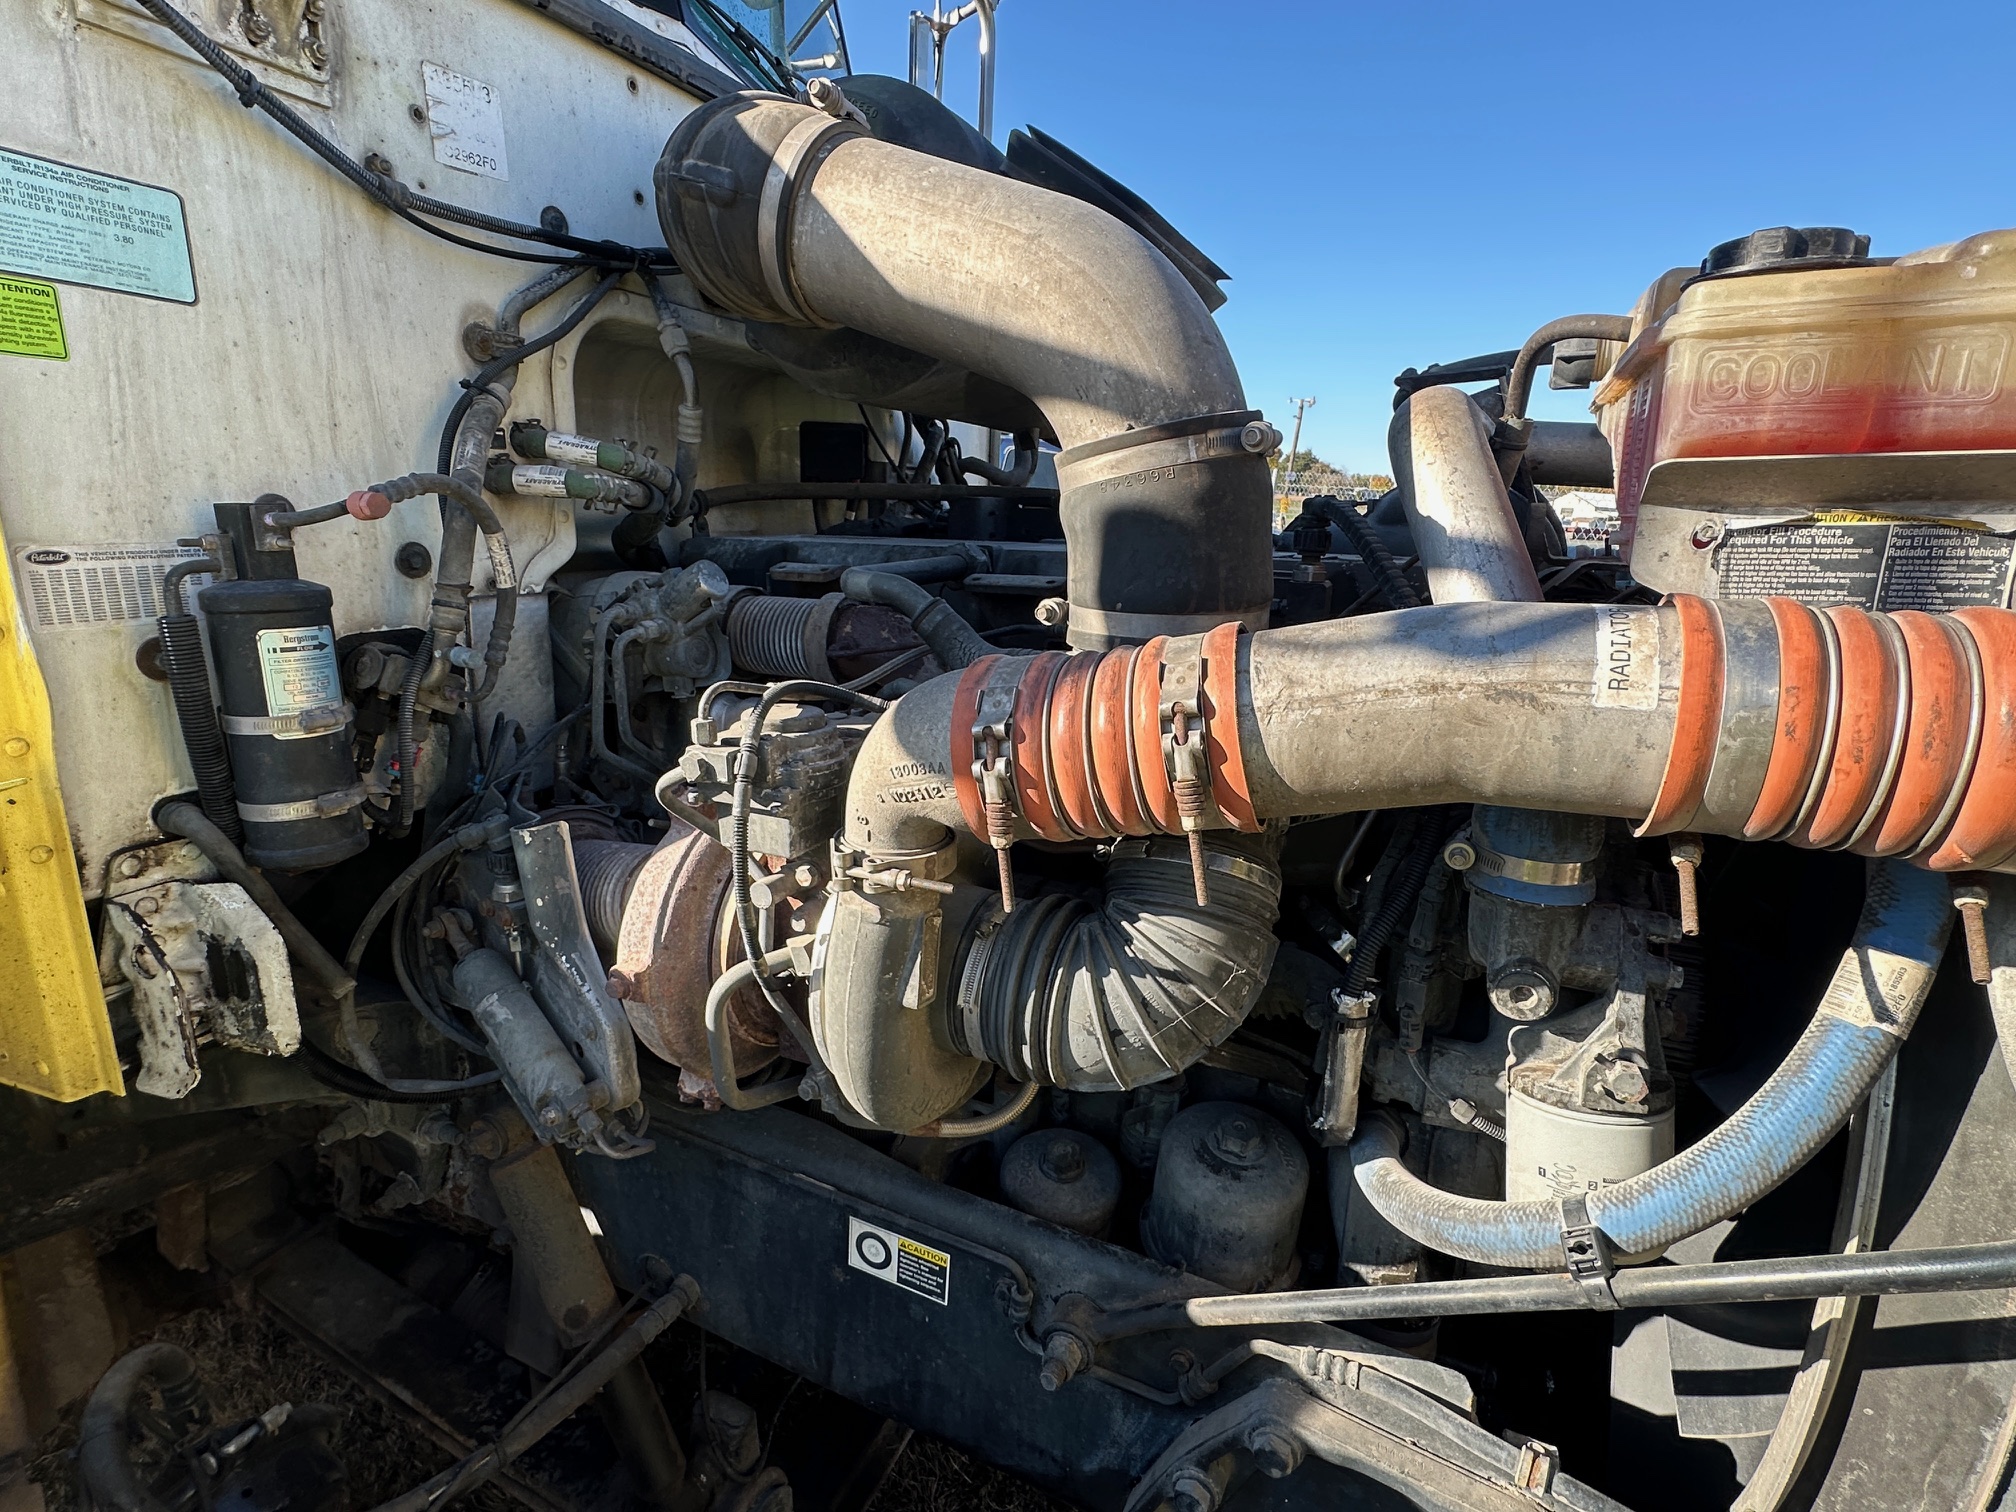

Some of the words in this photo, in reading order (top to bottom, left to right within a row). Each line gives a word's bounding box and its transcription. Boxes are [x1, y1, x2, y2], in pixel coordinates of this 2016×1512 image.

[11, 165, 48, 179] SERVICE
[50, 174, 110, 194] INSTRUCTIONS
[60, 170, 74, 179] AIR
[76, 174, 130, 193] CONDITIONER
[16, 180, 84, 202] CONDITIONER
[88, 197, 125, 213] SYSTEM
[128, 207, 171, 223] CONTAINS
[19, 190, 54, 205] UNDER
[58, 200, 82, 212] HIGH
[85, 204, 136, 224] PRESSURE.
[139, 218, 173, 232] SYSTEM
[45, 204, 57, 214] BY
[61, 208, 111, 228] QUALIFIED
[114, 221, 166, 238] PERSONNEL
[113, 234, 135, 245] 3.80
[1704, 343, 1981, 400] COOLANT
[1099, 466, 1176, 494] R66348
[1723, 535, 1768, 546] Required
[1770, 535, 1788, 545] For
[1790, 535, 1812, 545] This
[1814, 535, 1854, 545] Vehicle
[1787, 526, 1842, 537] Procedure
[1890, 537, 1911, 546] Para
[1913, 537, 1922, 546] El
[1925, 537, 1961, 546] Llenado
[1963, 537, 1979, 546] Del
[1893, 526, 1959, 536] Procedimiento
[30, 552, 66, 564] Peterbilt
[1889, 547, 1929, 557] Radiador
[1931, 548, 1943, 557] En
[1945, 548, 1966, 557] Este
[283, 634, 319, 644] Bergstrom
[1608, 608, 1631, 690] RADIATOR
[1888, 966, 1908, 992] 185503
[906, 1243, 947, 1264] CAUTION
